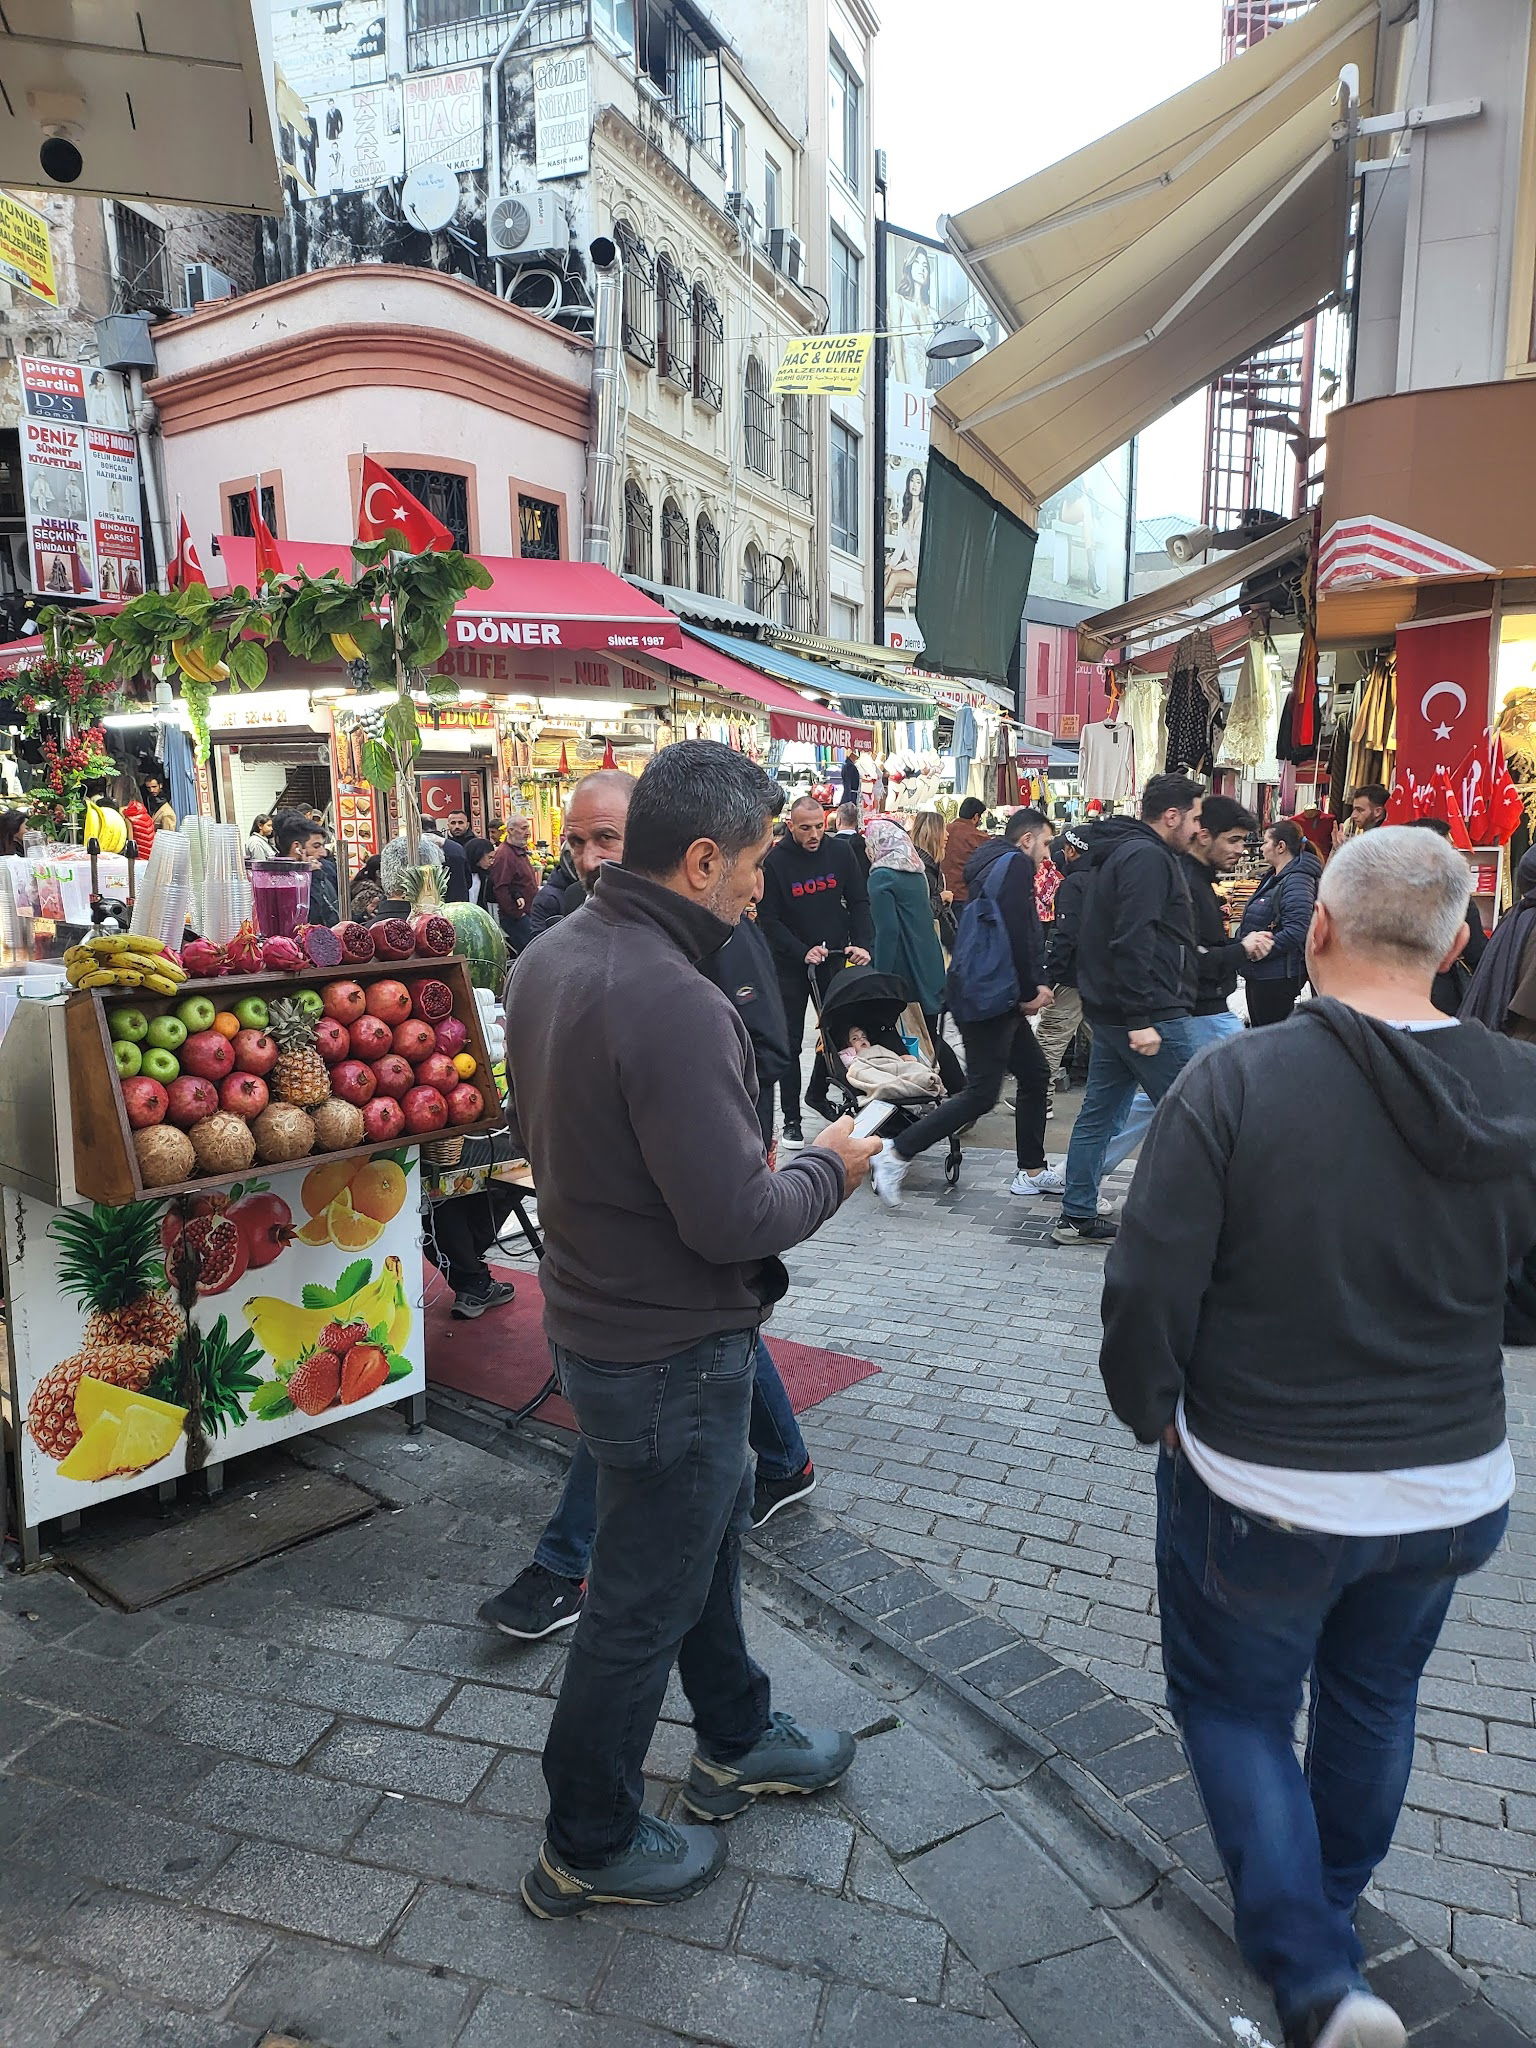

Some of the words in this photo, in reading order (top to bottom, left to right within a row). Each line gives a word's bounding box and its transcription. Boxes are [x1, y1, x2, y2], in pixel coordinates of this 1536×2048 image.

[535, 58, 586, 90] GÖZDE
[406, 71, 480, 104] BUHARA
[353, 91, 379, 160] NAZAR
[454, 159, 470, 169] KAT
[569, 155, 583, 164] HAN
[350, 160, 385, 178] GİYİM
[802, 338, 858, 350] YUNUS
[782, 352, 808, 366] HAC
[812, 352, 820, 363] &
[826, 350, 864, 363] UMRE
[25, 361, 76, 378] pierre
[777, 367, 860, 375] MALZEMELERİ
[26, 376, 79, 393] cardin
[33, 392, 74, 411] D'S
[35, 410, 76, 419] damat
[904, 392, 930, 432] PE
[27, 425, 78, 448] DENİZ
[89, 430, 110, 449] GENÇ
[110, 434, 134, 451] MODA
[36, 443, 72, 458] SÜNNET
[28, 454, 82, 470] KIYAFETLERİ
[101, 462, 128, 473] BOHÇASI
[112, 455, 133, 464] DAMAT
[97, 470, 133, 482] HAZIRLANIR
[41, 517, 80, 530] NEHİR
[116, 514, 135, 522] KATTA
[34, 528, 74, 543] SEÇKİN
[103, 533, 134, 544] ÇARŞISI
[35, 542, 76, 554] BİNDALLI
[456, 618, 562, 645] DÖNER
[607, 634, 639, 646] SİNCE
[641, 636, 665, 645] 1987
[904, 637, 920, 649] pierre
[575, 661, 611, 687] NUR
[797, 722, 818, 742] NUR
[820, 723, 851, 747] DÖNER
[1065, 831, 1089, 851] adidas
[791, 873, 838, 898] BOSS
[555, 1866, 595, 1890] SALOMON
